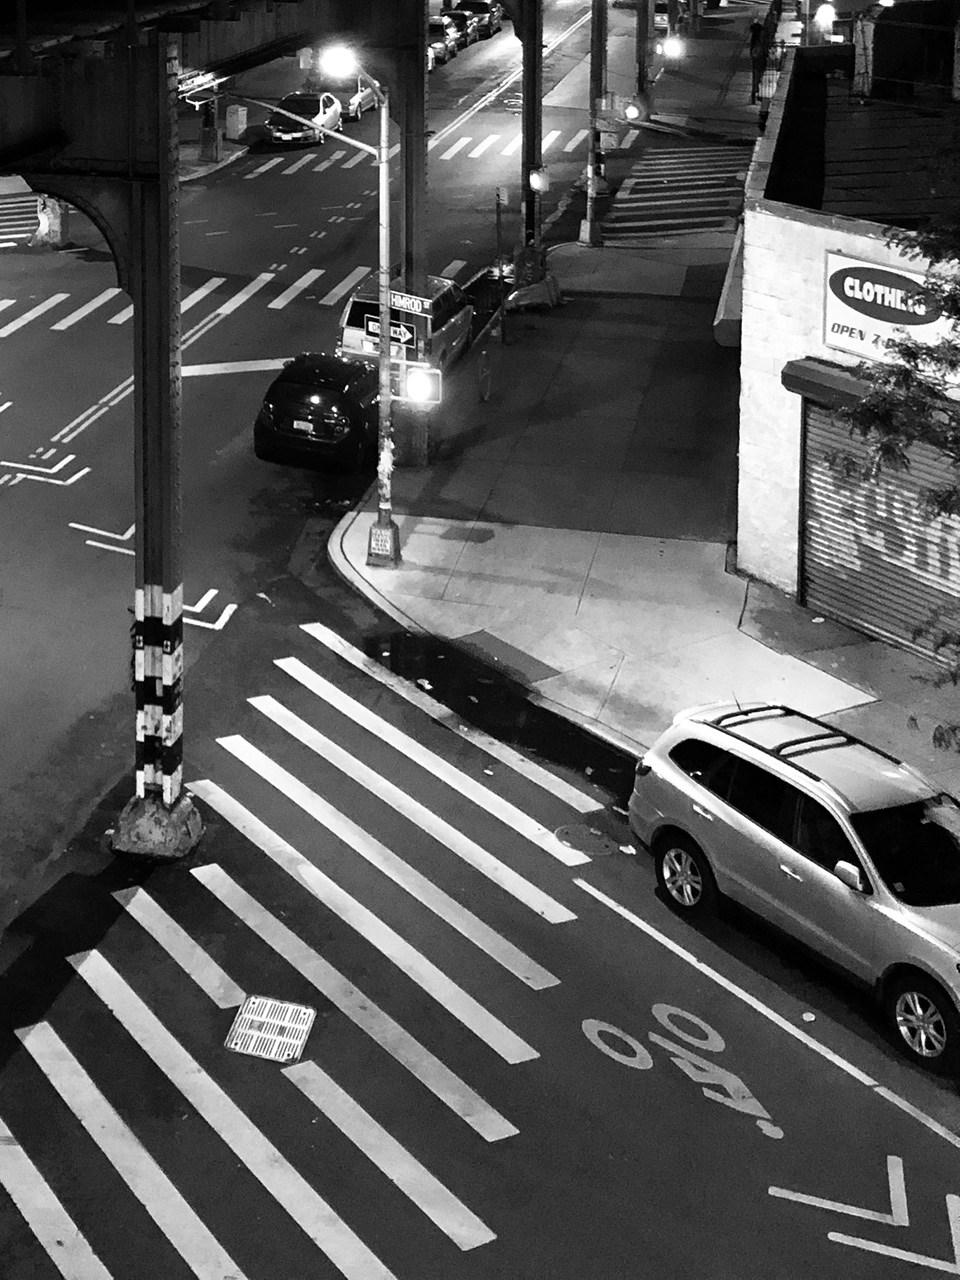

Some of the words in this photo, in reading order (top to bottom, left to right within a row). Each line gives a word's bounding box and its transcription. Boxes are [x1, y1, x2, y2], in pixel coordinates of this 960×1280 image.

[391, 293, 422, 313] HIMROD
[423, 301, 430, 309] ST
[392, 327, 408, 339] WAY
[830, 322, 867, 341] OPEN
